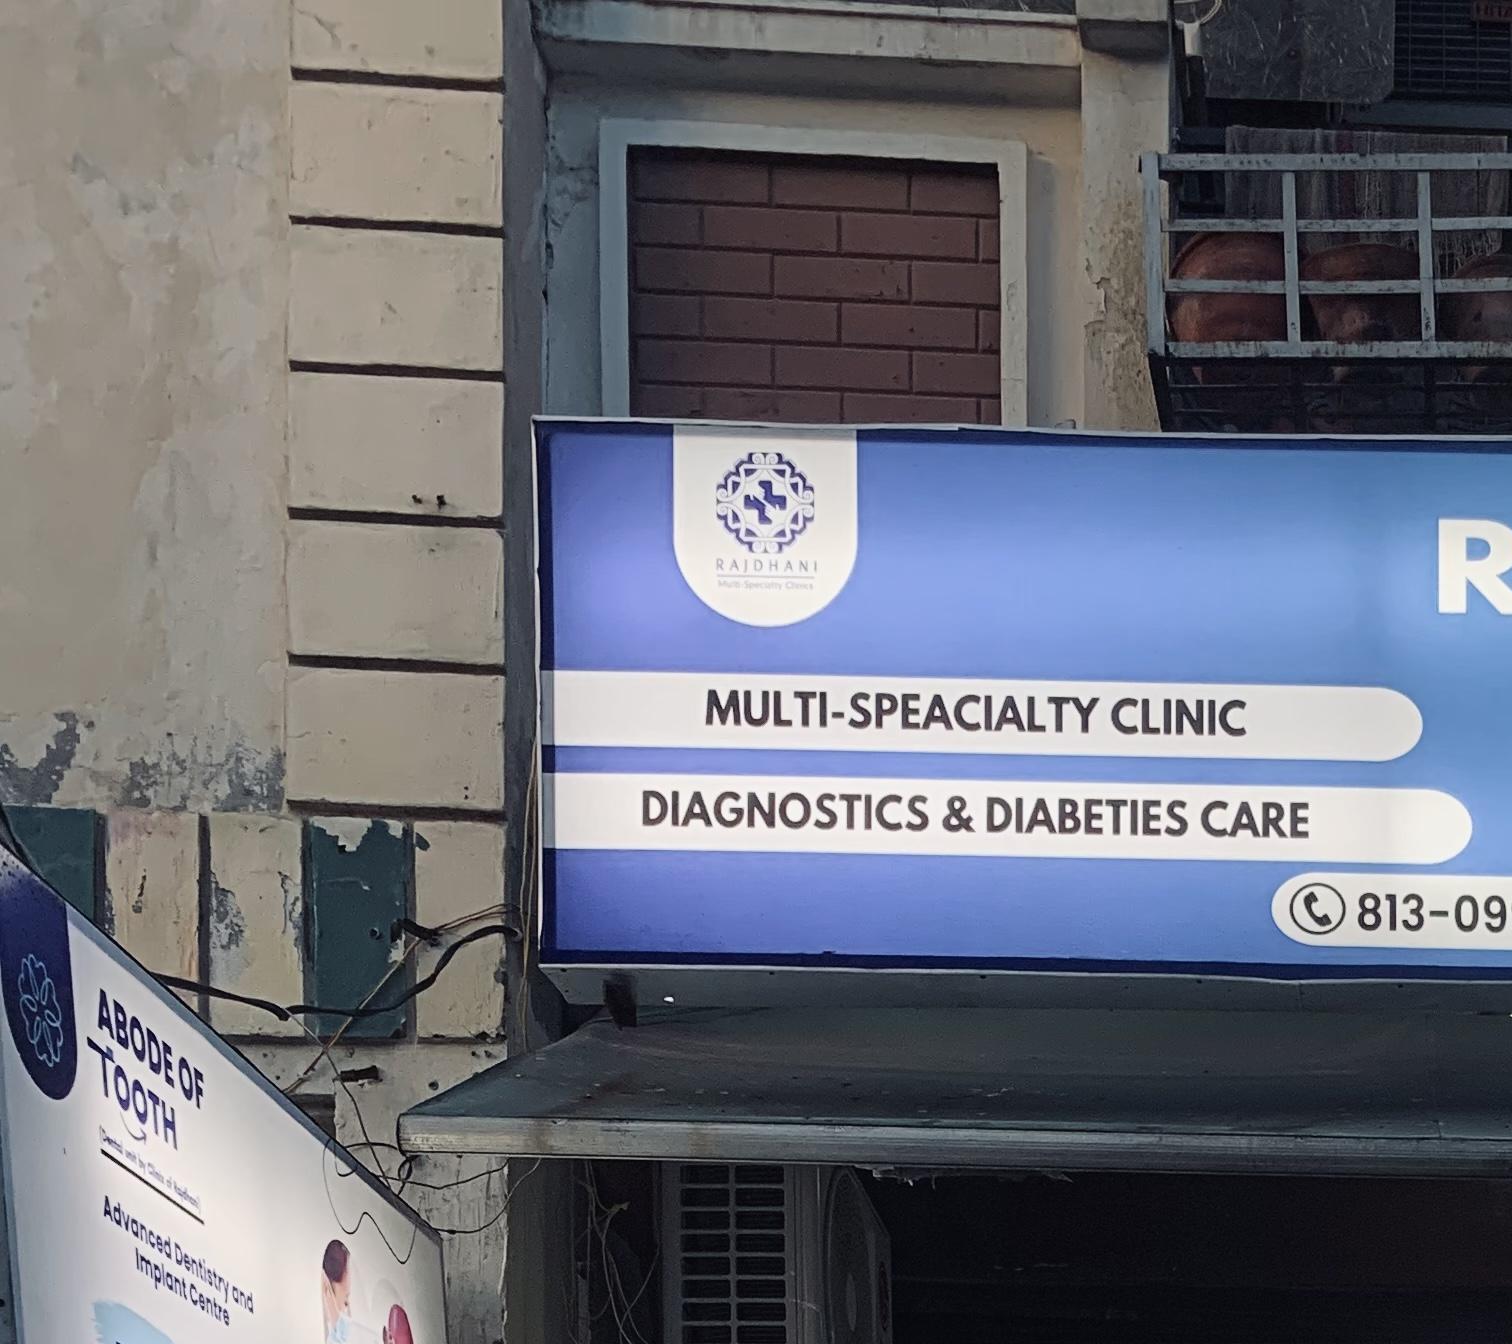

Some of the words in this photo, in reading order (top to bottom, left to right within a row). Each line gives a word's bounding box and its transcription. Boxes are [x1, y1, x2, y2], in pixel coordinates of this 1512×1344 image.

[716, 557, 818, 573] RAJDHANI
[704, 689, 1100, 736] MULTI-SPEACIALTY
[1110, 696, 1248, 738] CLINIC
[640, 789, 931, 834] DIAGNOSTICS
[943, 796, 976, 834] &
[986, 797, 1189, 838] DIABETIES
[1200, 801, 1311, 841] CARE
[97, 987, 175, 1089] ABODE
[178, 1056, 204, 1110] OF
[86, 1036, 178, 1151] TOOTH
[103, 1194, 173, 1260] Advanced
[174, 1241, 229, 1304] Dentistry
[231, 1283, 255, 1315] and
[135, 1247, 189, 1302] Implant
[188, 1282, 231, 1327] Centre
